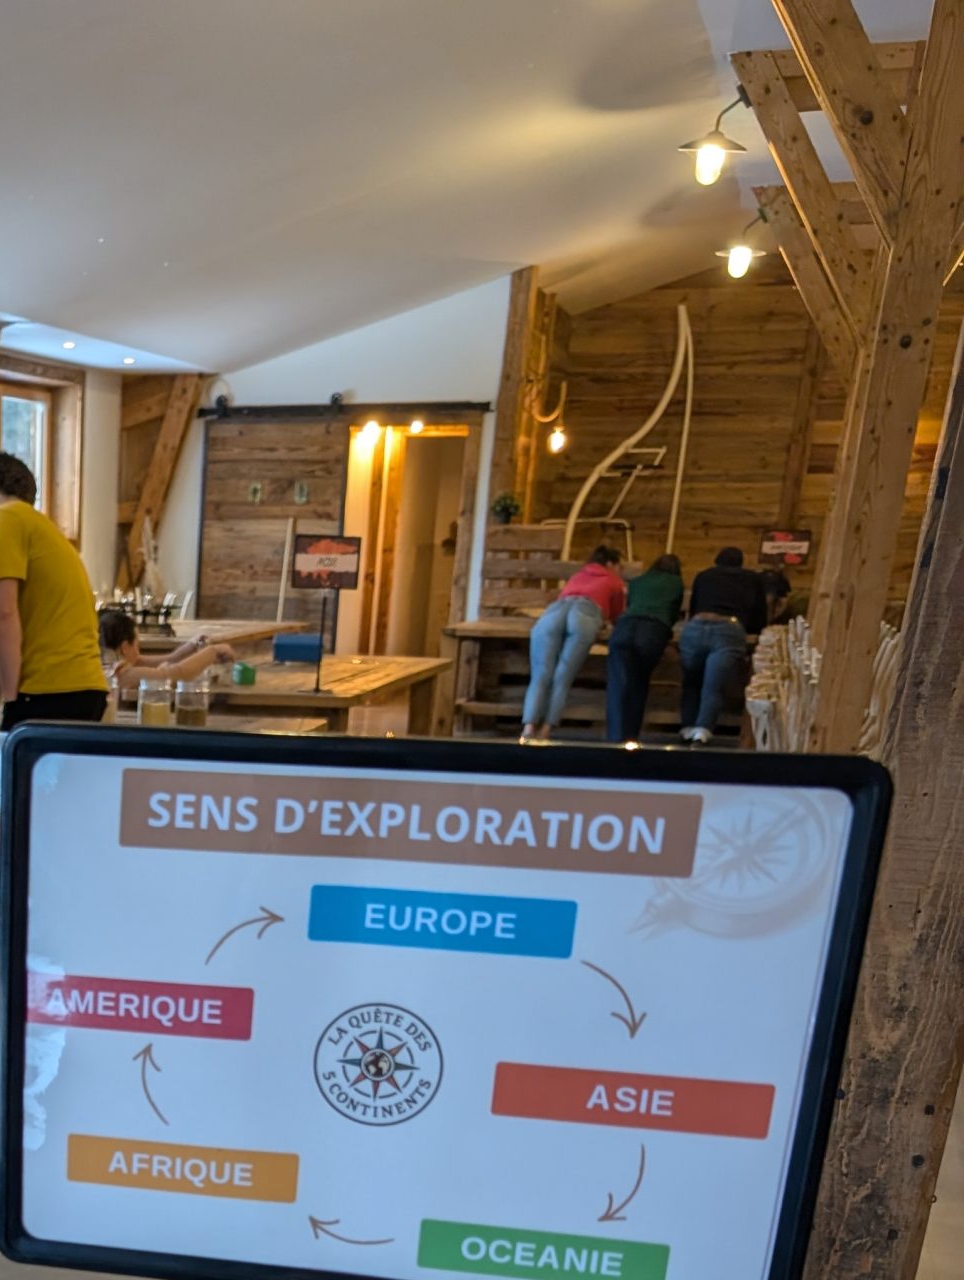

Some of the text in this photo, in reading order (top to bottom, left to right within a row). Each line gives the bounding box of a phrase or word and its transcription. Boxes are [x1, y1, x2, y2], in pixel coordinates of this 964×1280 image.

[147, 791, 666, 855] SENS D'EXPLORATION
[364, 903, 518, 939] EUROPE
[46, 988, 223, 1027] AMERIQUE
[327, 1007, 432, 1052] LA QUÊTE DES
[322, 1071, 432, 1118] 5 CONTINENTS
[585, 1084, 675, 1117] ASIE
[108, 1151, 254, 1188] AFRIQUE
[460, 1236, 624, 1277] OCEANIE
